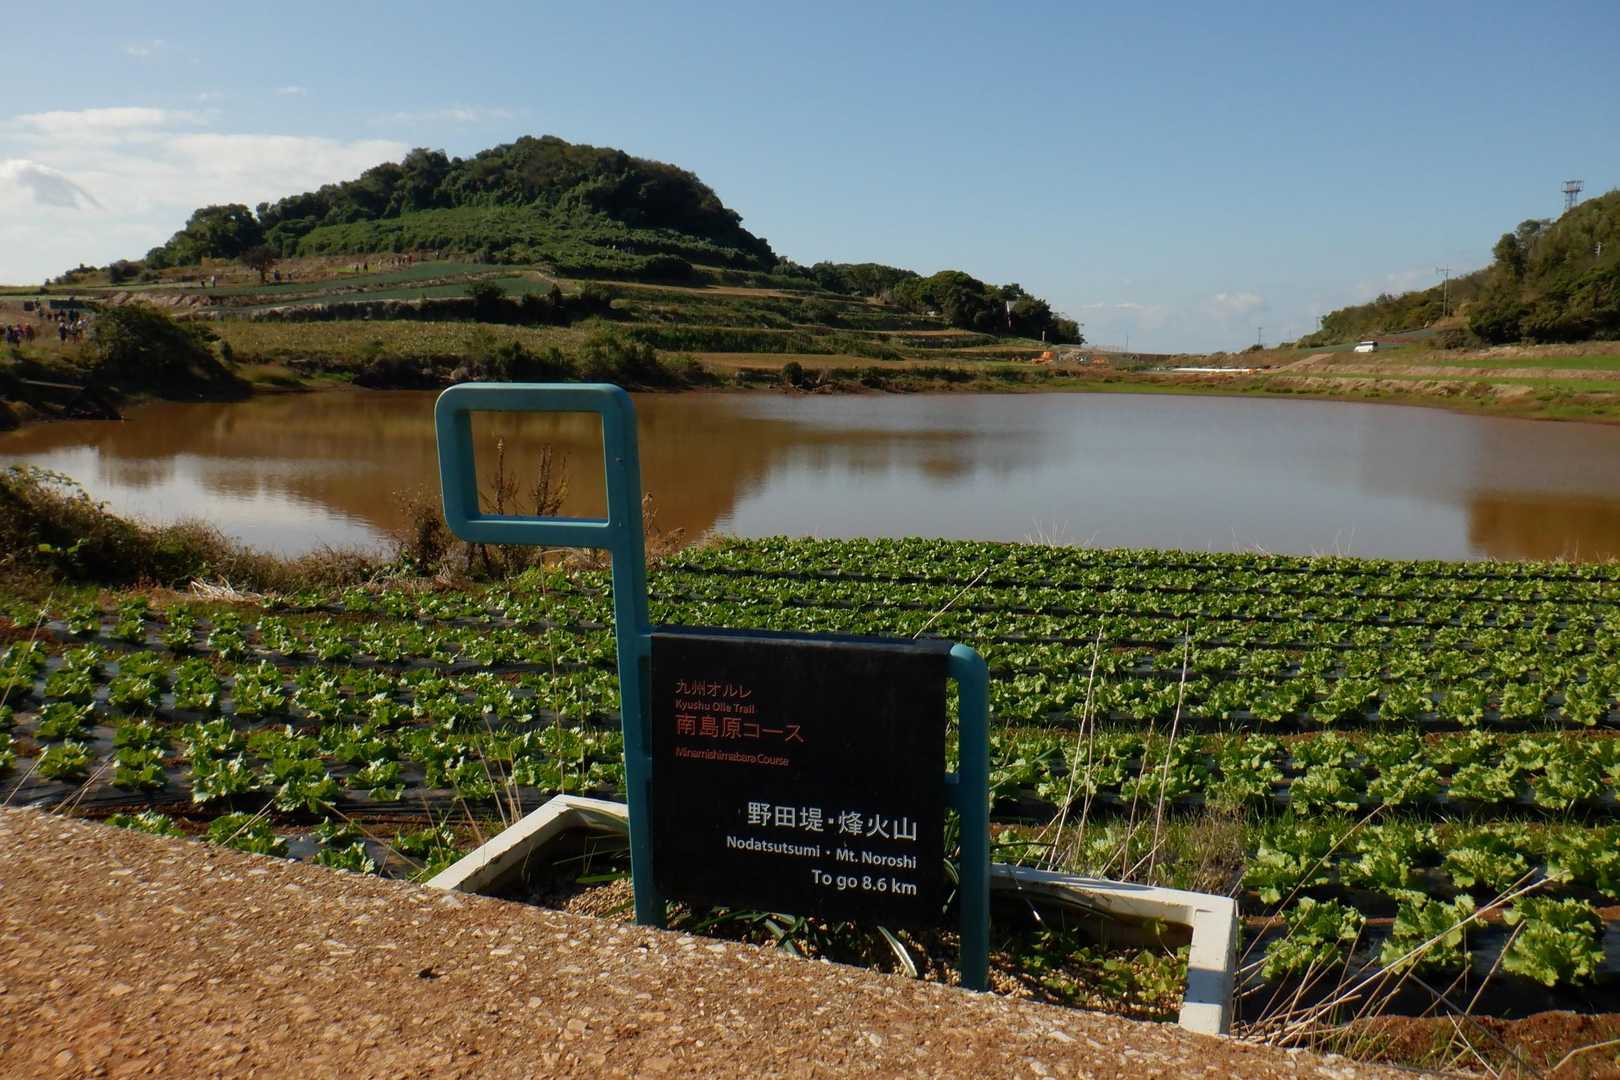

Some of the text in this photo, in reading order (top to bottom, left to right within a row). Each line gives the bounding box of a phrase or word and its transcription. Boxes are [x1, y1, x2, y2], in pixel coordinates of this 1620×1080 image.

[675, 679, 752, 697] 九州オルレ
[675, 699, 755, 714] Kyushu Olle Trail
[675, 713, 805, 743] 南島原コース
[757, 754, 789, 766] Course
[726, 835, 820, 857] Nodatsutsumi
[835, 848, 859, 863] Mt.
[862, 851, 917, 869] Noroshi
[812, 870, 917, 896] To go 8.6 km
